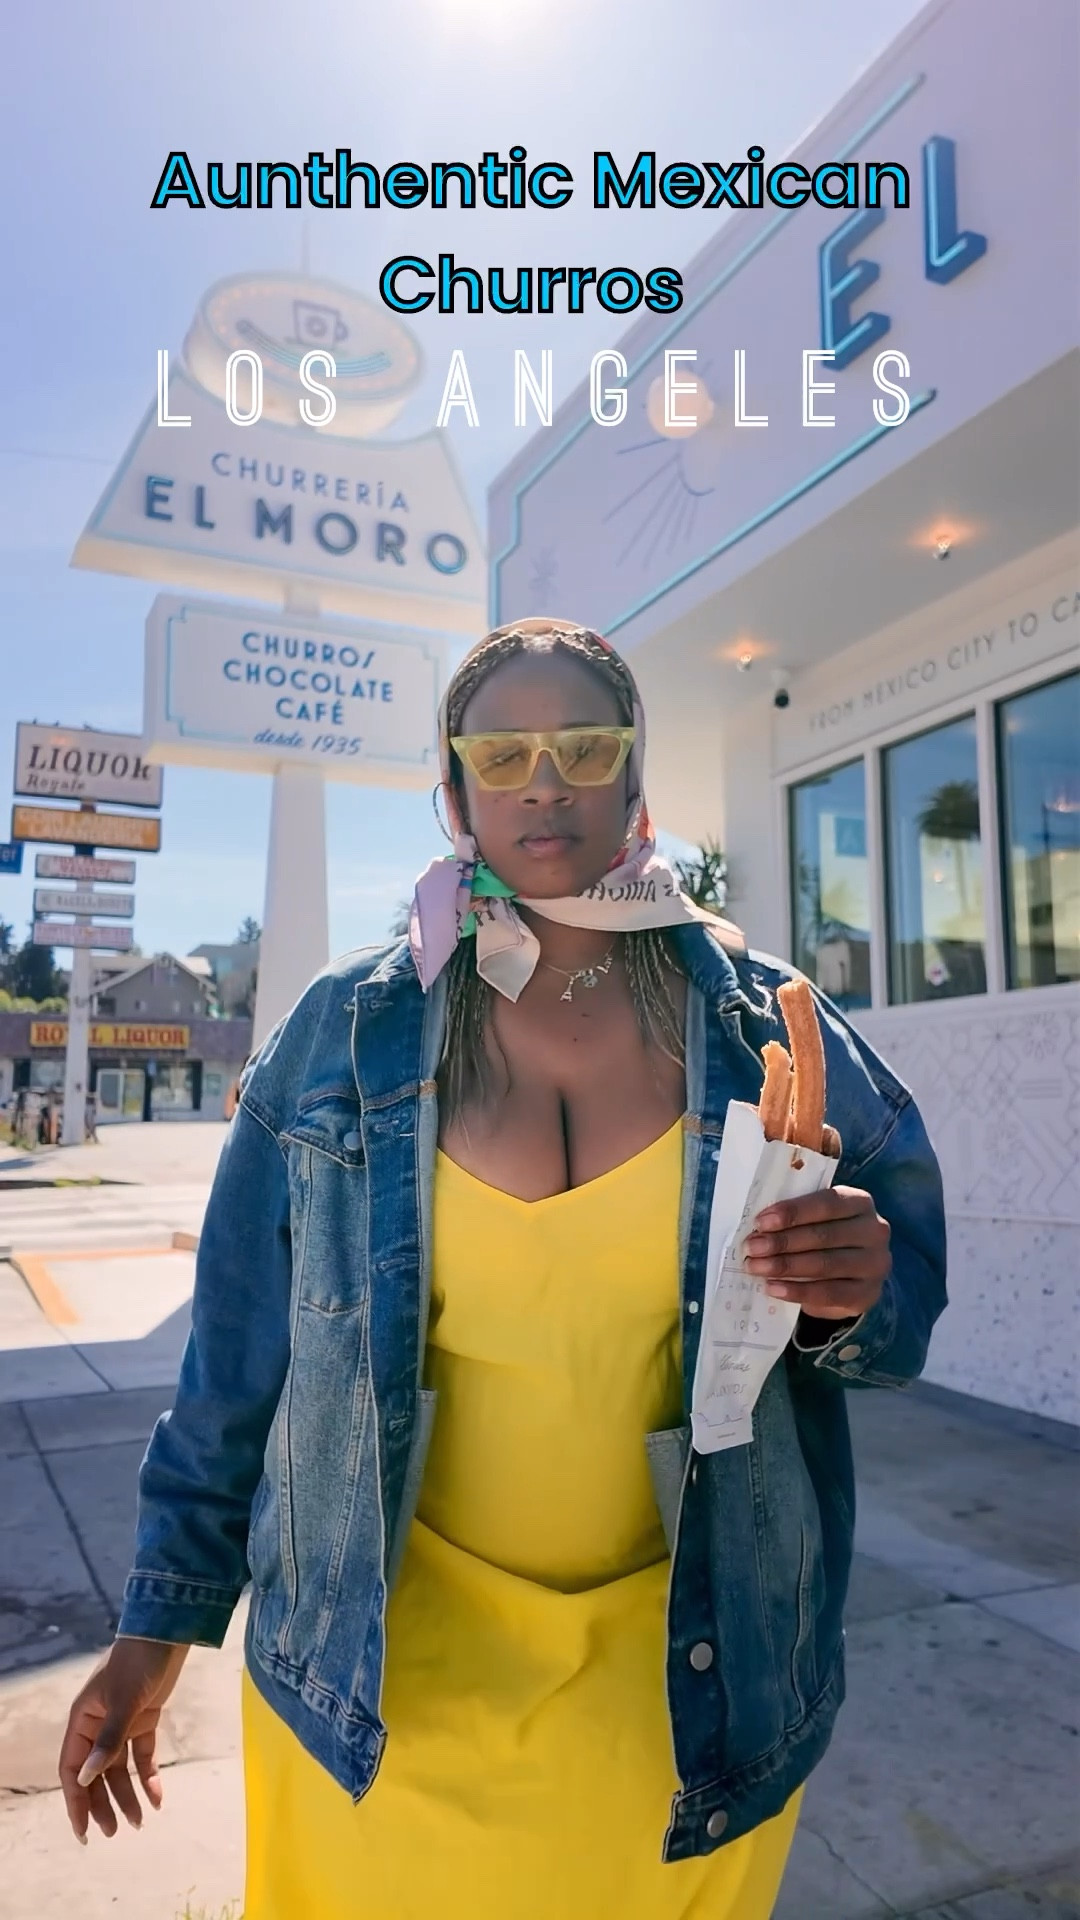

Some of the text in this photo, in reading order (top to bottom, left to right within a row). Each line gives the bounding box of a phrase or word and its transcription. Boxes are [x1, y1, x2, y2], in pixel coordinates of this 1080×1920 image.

[211, 452, 411, 513] CHURRERÍA
[145, 475, 470, 575] EL MORO
[241, 631, 377, 669] CHURROS
[862, 659, 937, 707] MEXICO
[947, 629, 996, 671] CITY
[1008, 612, 1038, 643] TO
[222, 659, 393, 702] CHOCOLATE
[275, 697, 345, 726] CAFÉ
[253, 728, 364, 755] desde 1935
[35, 1023, 184, 1045] ROL LIQUOR
